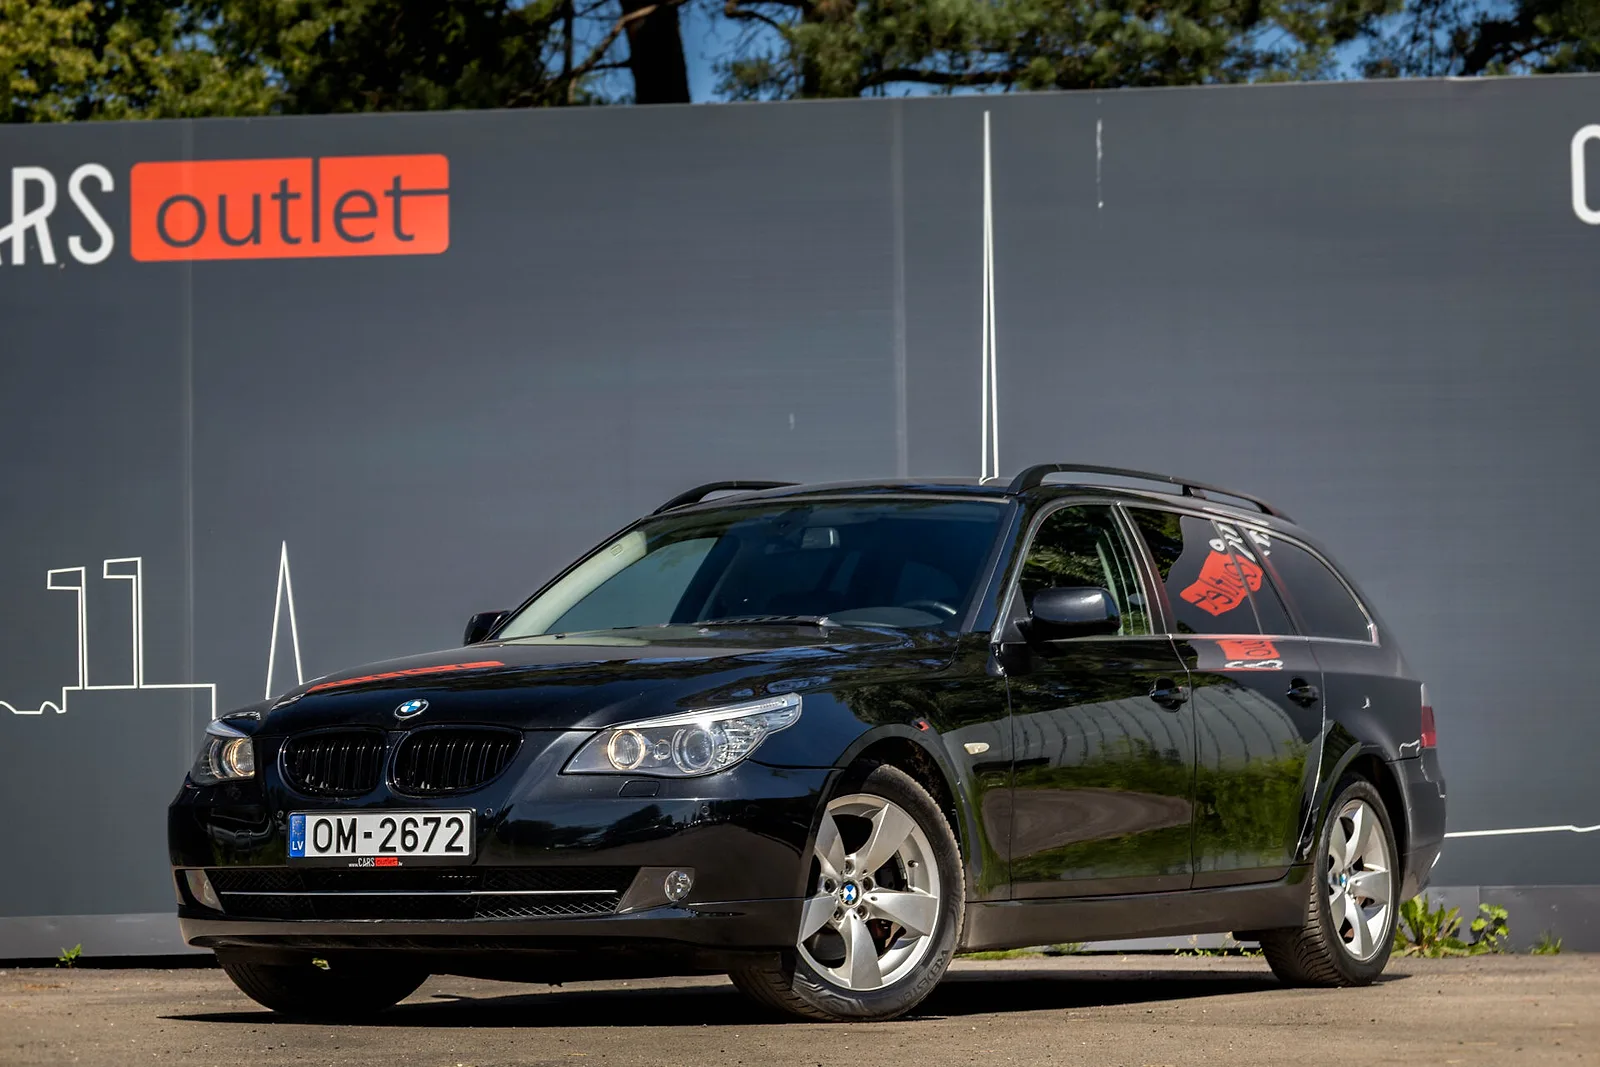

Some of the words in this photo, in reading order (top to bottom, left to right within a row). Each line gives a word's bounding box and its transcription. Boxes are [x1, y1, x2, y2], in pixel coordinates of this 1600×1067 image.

[0, 163, 115, 266] RS
[156, 158, 449, 250] outlet
[292, 841, 304, 851] LV
[312, 817, 464, 853] OM-2672
